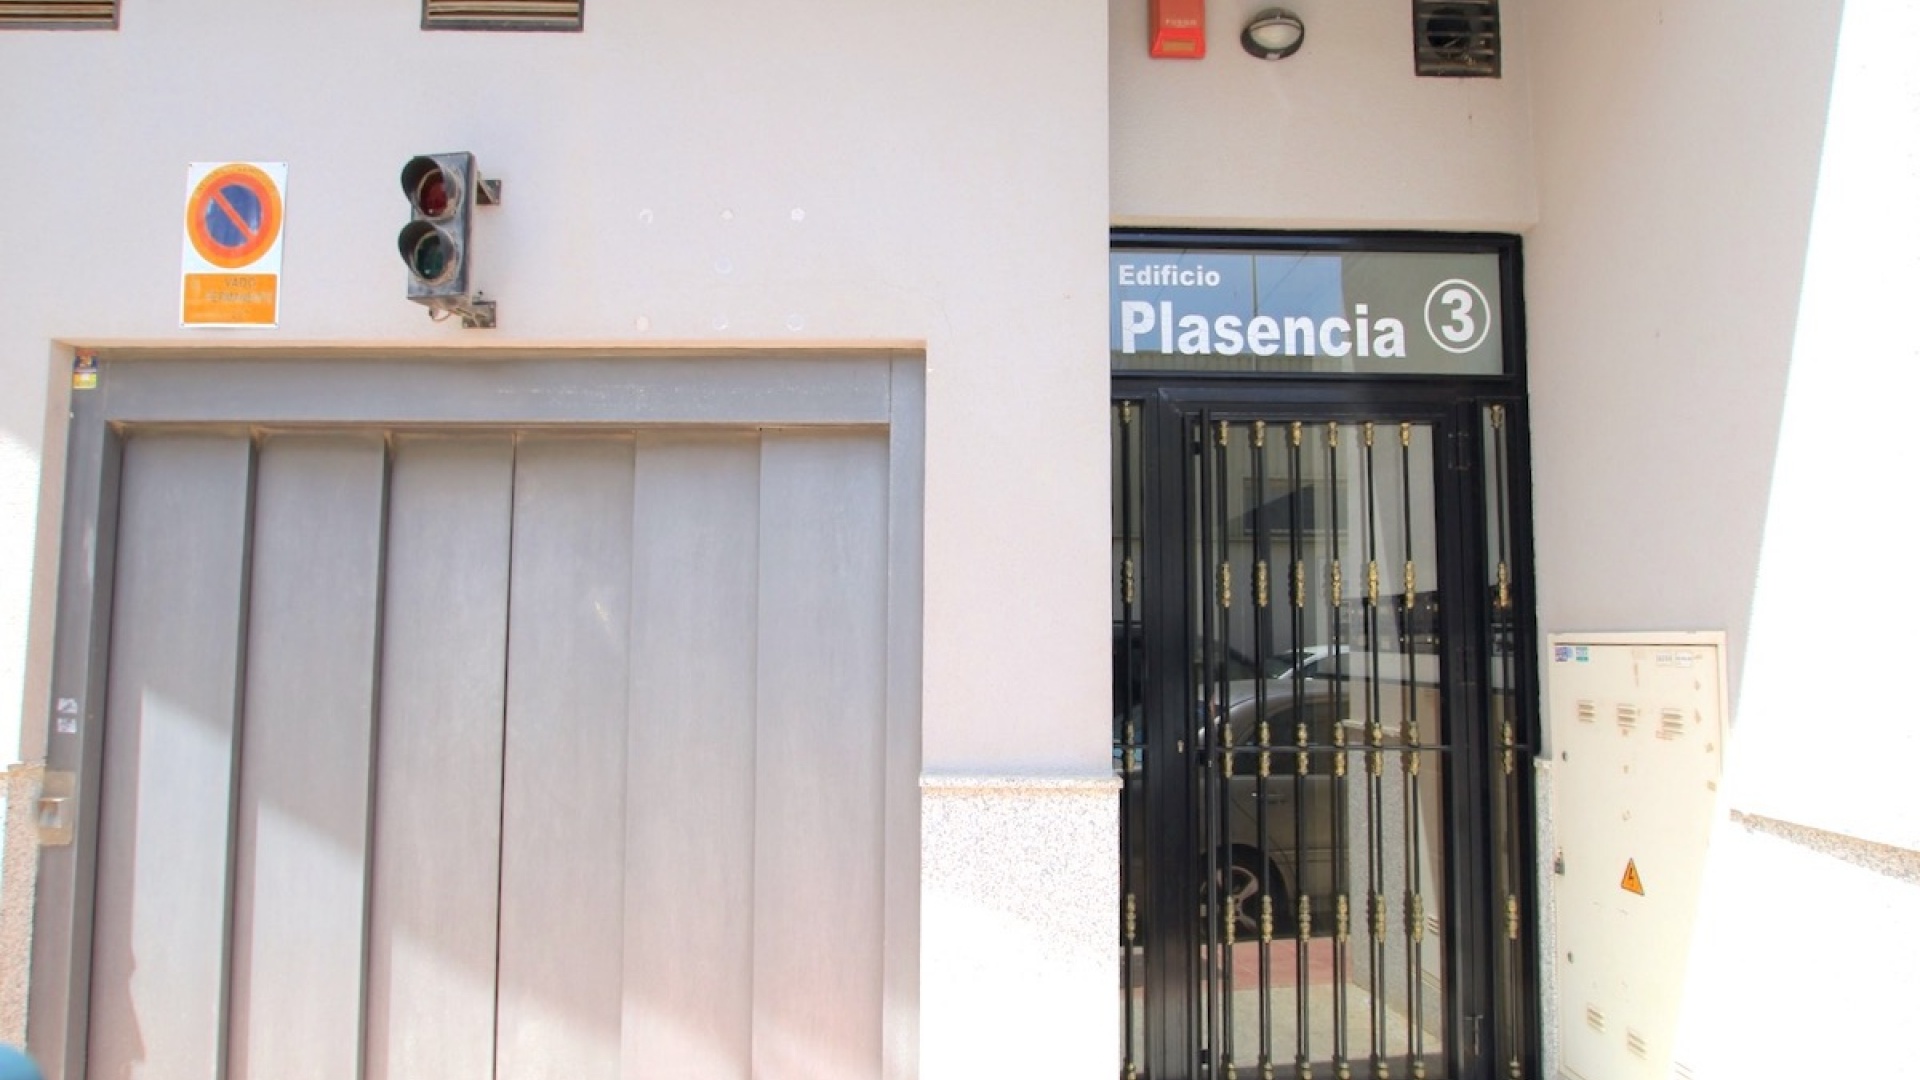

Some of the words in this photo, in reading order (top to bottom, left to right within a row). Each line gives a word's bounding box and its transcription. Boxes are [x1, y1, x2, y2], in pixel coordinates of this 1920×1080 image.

[1119, 264, 1221, 286] Edificio
[1121, 301, 1406, 358] Plasencia
[1441, 288, 1475, 342] 3
